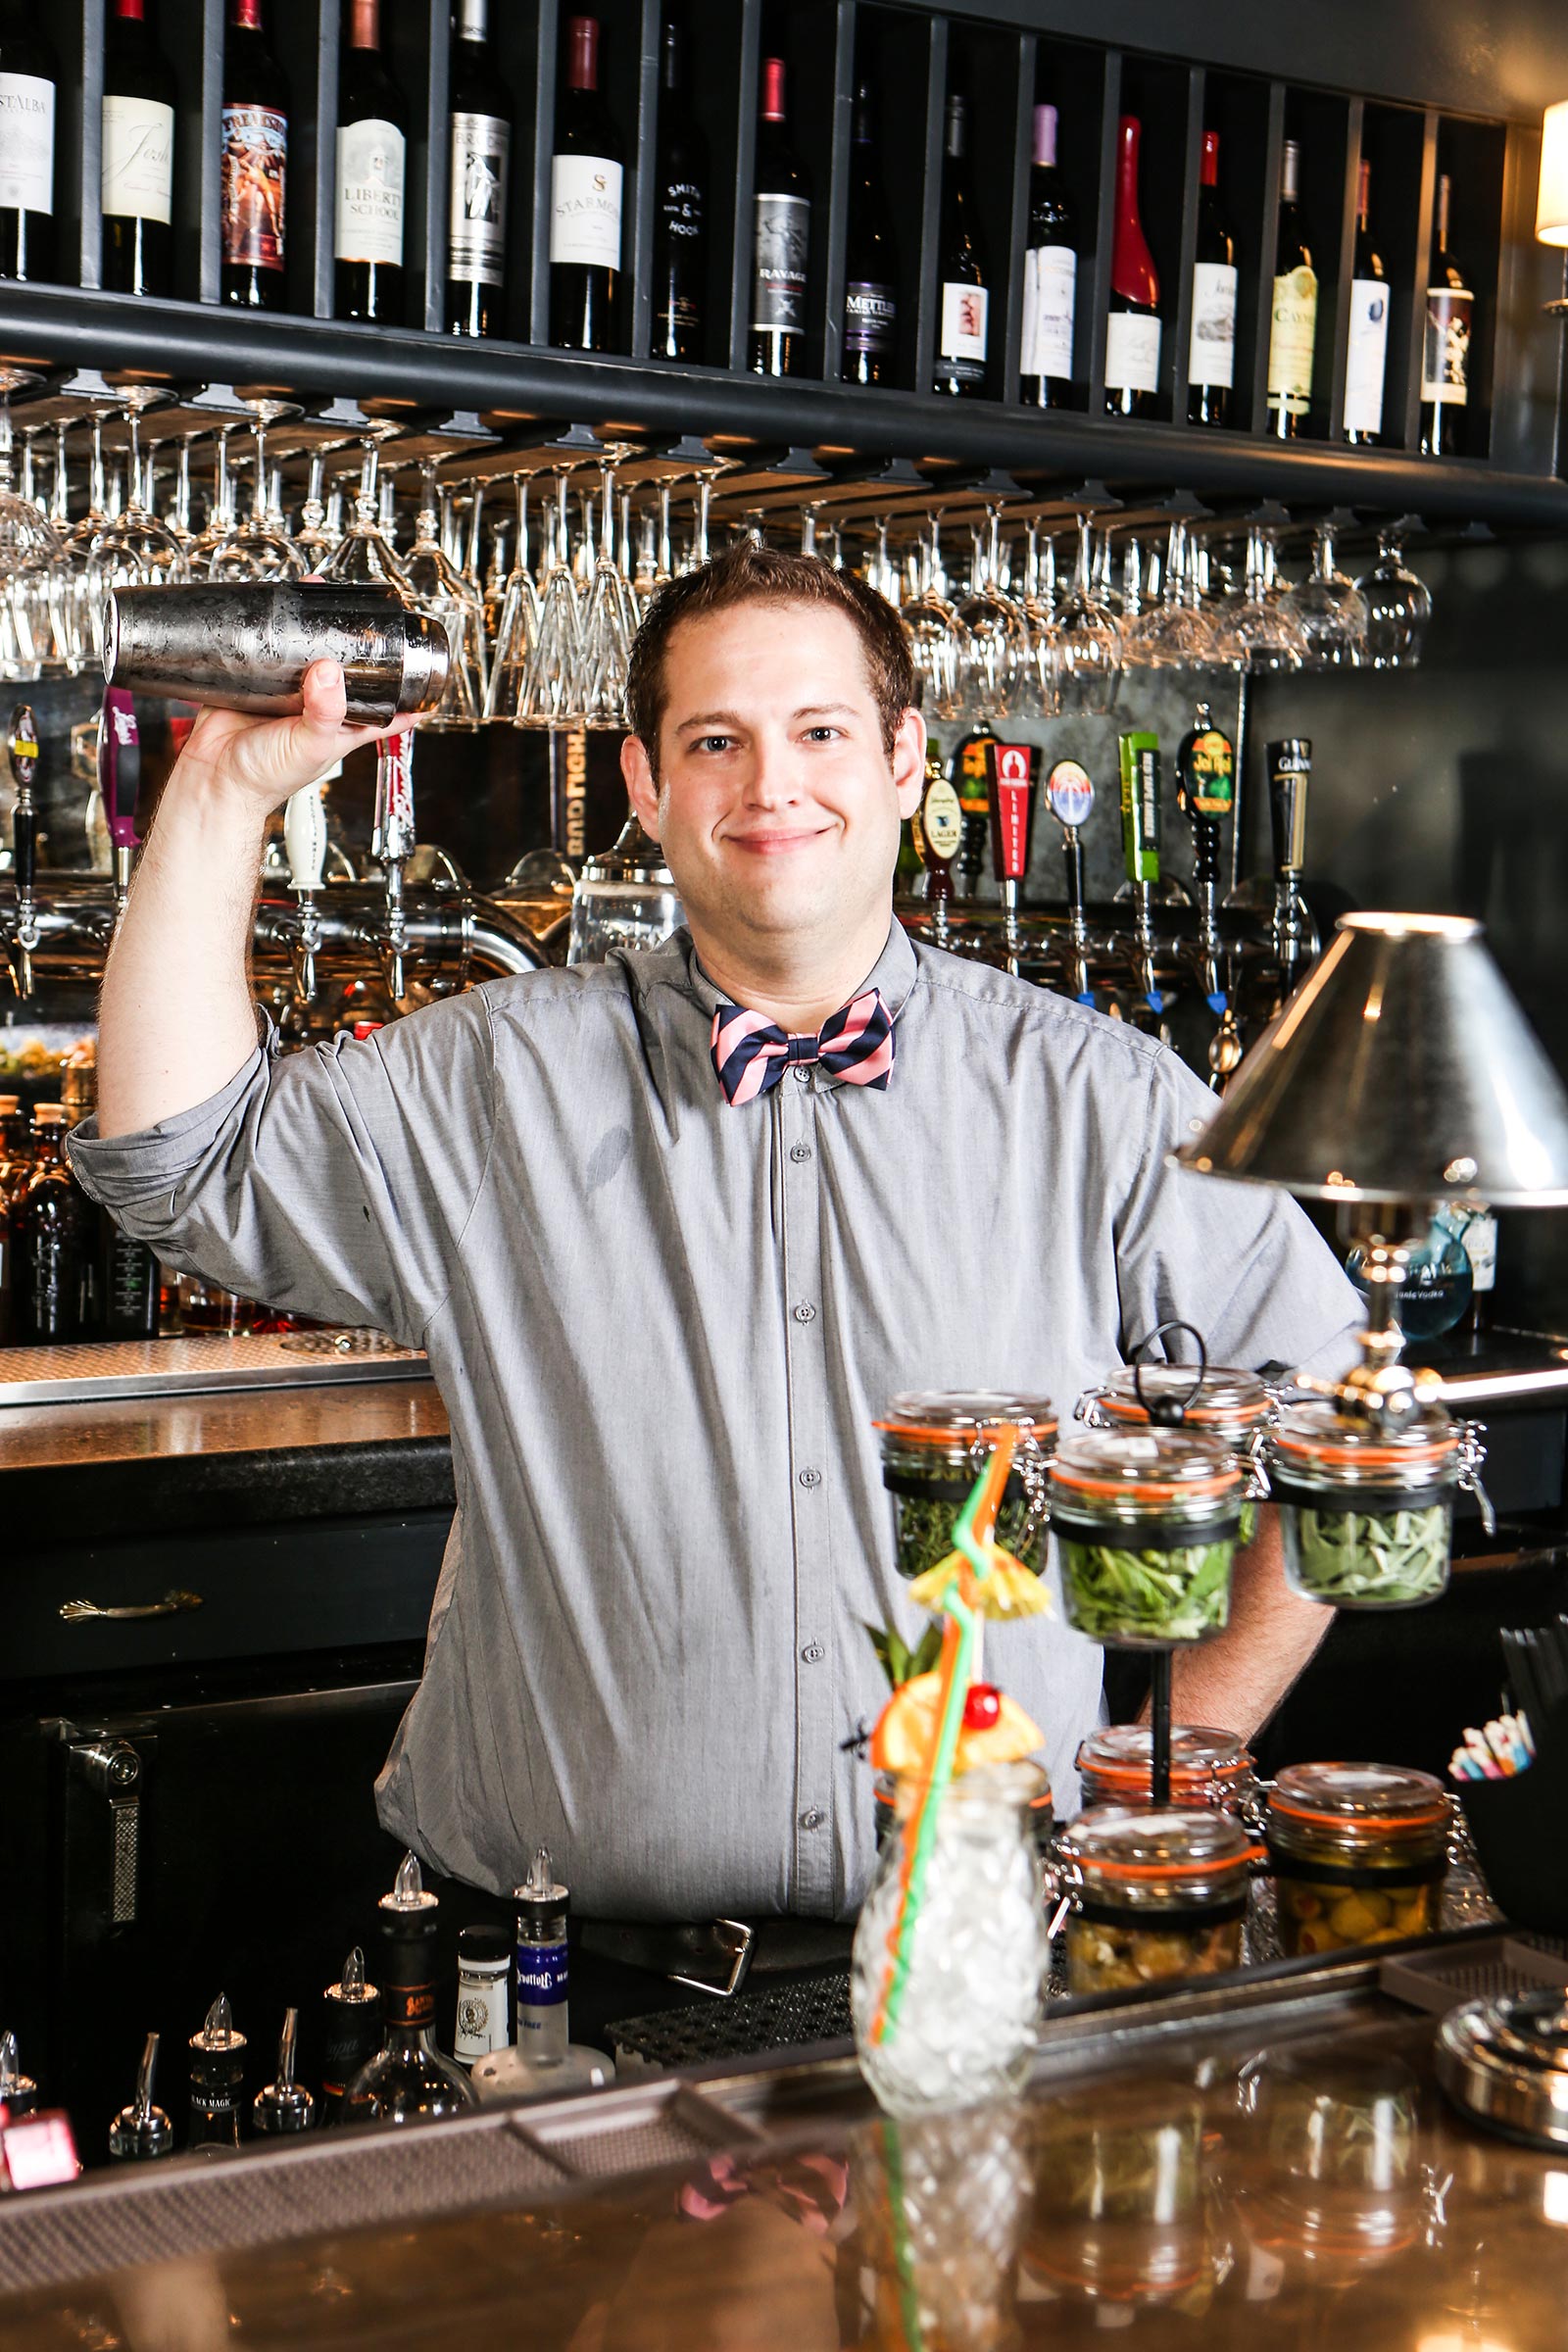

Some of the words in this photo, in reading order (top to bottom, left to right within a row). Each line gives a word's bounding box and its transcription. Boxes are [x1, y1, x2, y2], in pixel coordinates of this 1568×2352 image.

[350, 205, 400, 220] SCHOOL
[681, 203, 692, 218] &
[760, 268, 807, 283] RAVAGE
[1010, 790, 1019, 873] LIMITED
[191, 2093, 207, 2107] LACK
[209, 2097, 231, 2108] MAGIC
